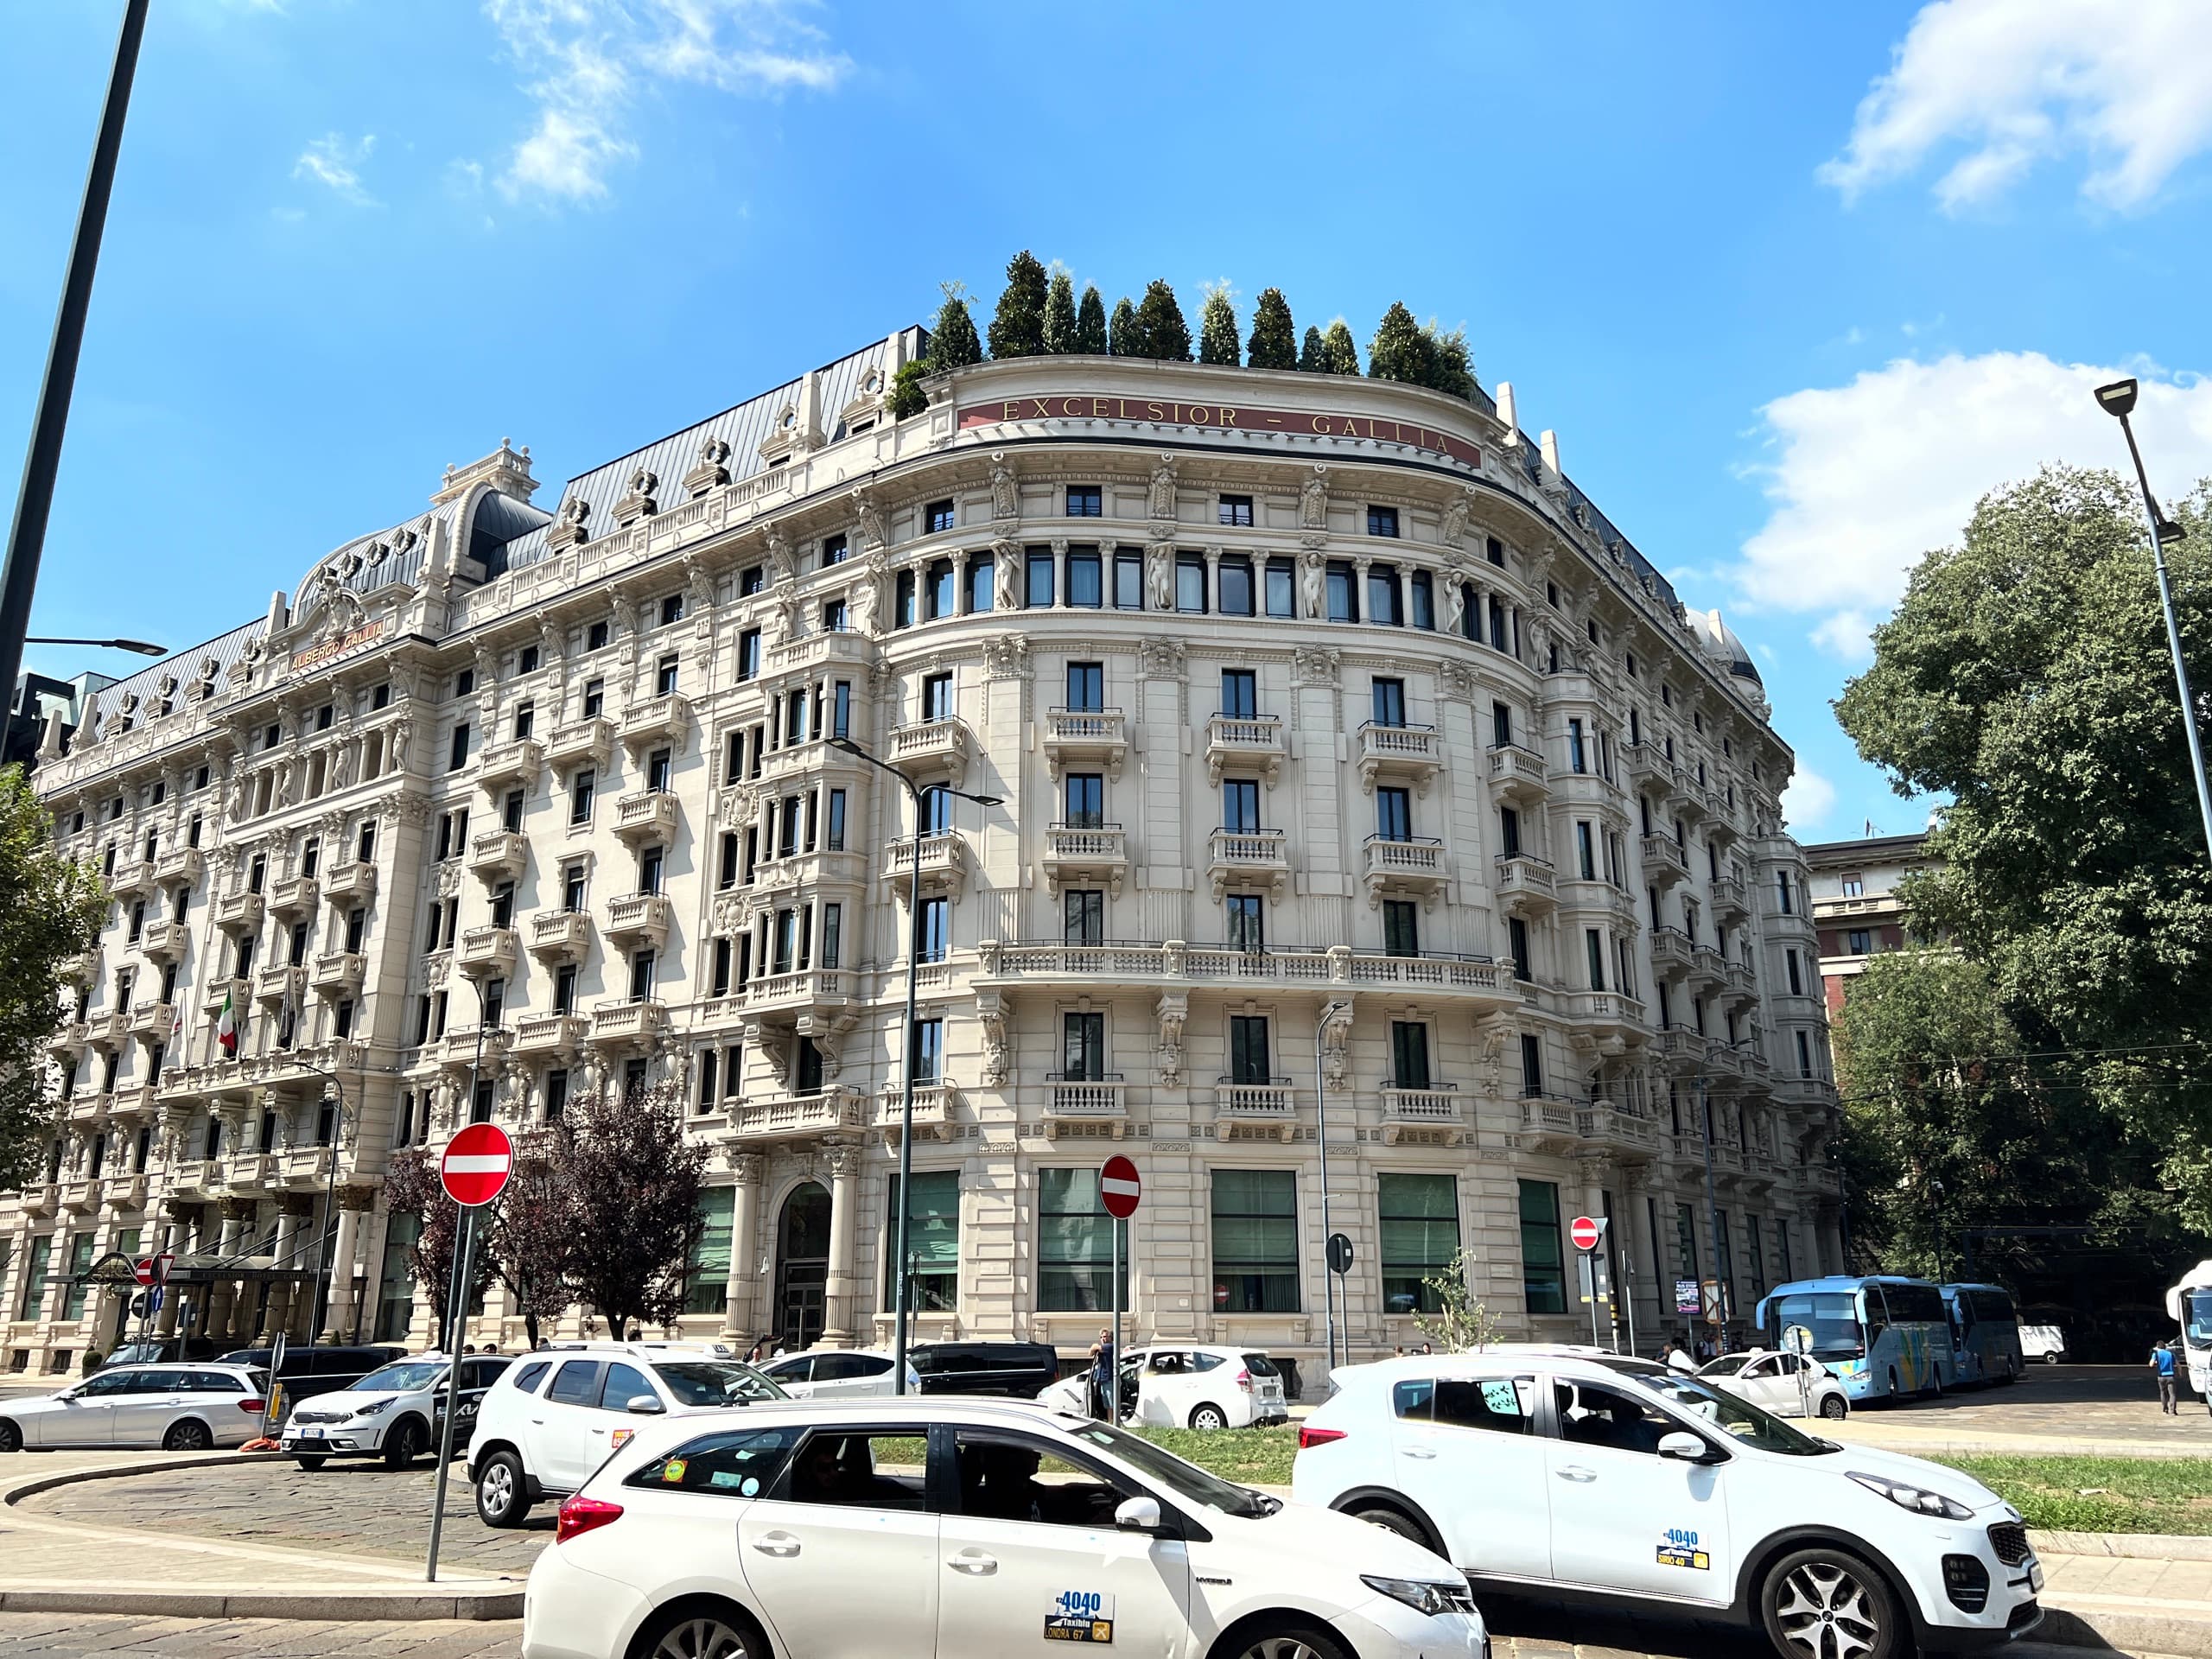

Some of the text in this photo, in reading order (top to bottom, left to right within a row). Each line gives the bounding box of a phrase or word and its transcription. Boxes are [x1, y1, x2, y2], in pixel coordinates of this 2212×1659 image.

[1002, 397, 1237, 427] EXCELSIOR
[1312, 415, 1449, 454] GALLIA
[291, 626, 384, 671] ALBERGO GALLIA
[1668, 1529, 1698, 1548] 4040
[1675, 1558, 1685, 1567] 40
[1062, 1591, 1101, 1615] 4040
[1045, 1627, 1070, 1638] LONDRA
